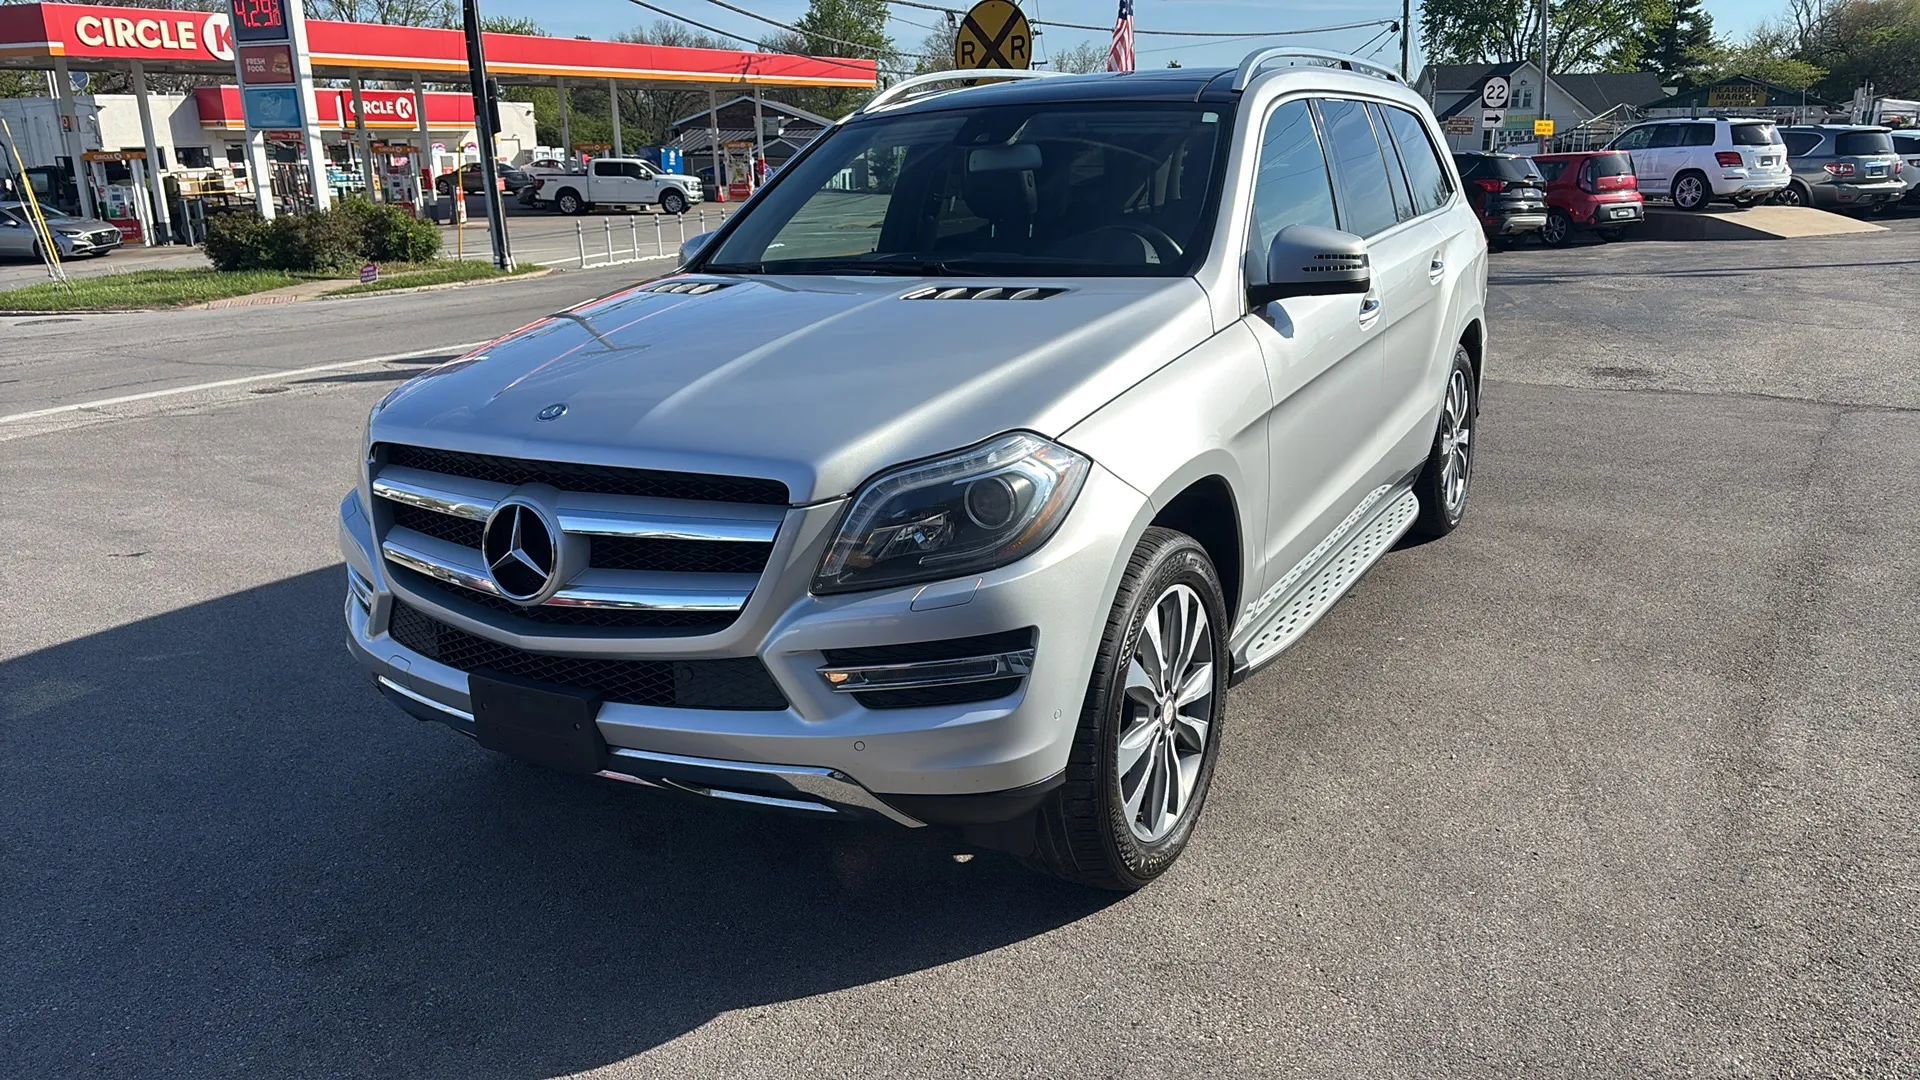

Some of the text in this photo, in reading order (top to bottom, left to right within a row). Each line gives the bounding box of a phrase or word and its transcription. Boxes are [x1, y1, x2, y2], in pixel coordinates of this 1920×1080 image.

[75, 15, 233, 52] CIRCLE K
[246, 57, 266, 65] FRESH
[1486, 84, 1505, 99] 22
[349, 100, 412, 115] CRCLE K
